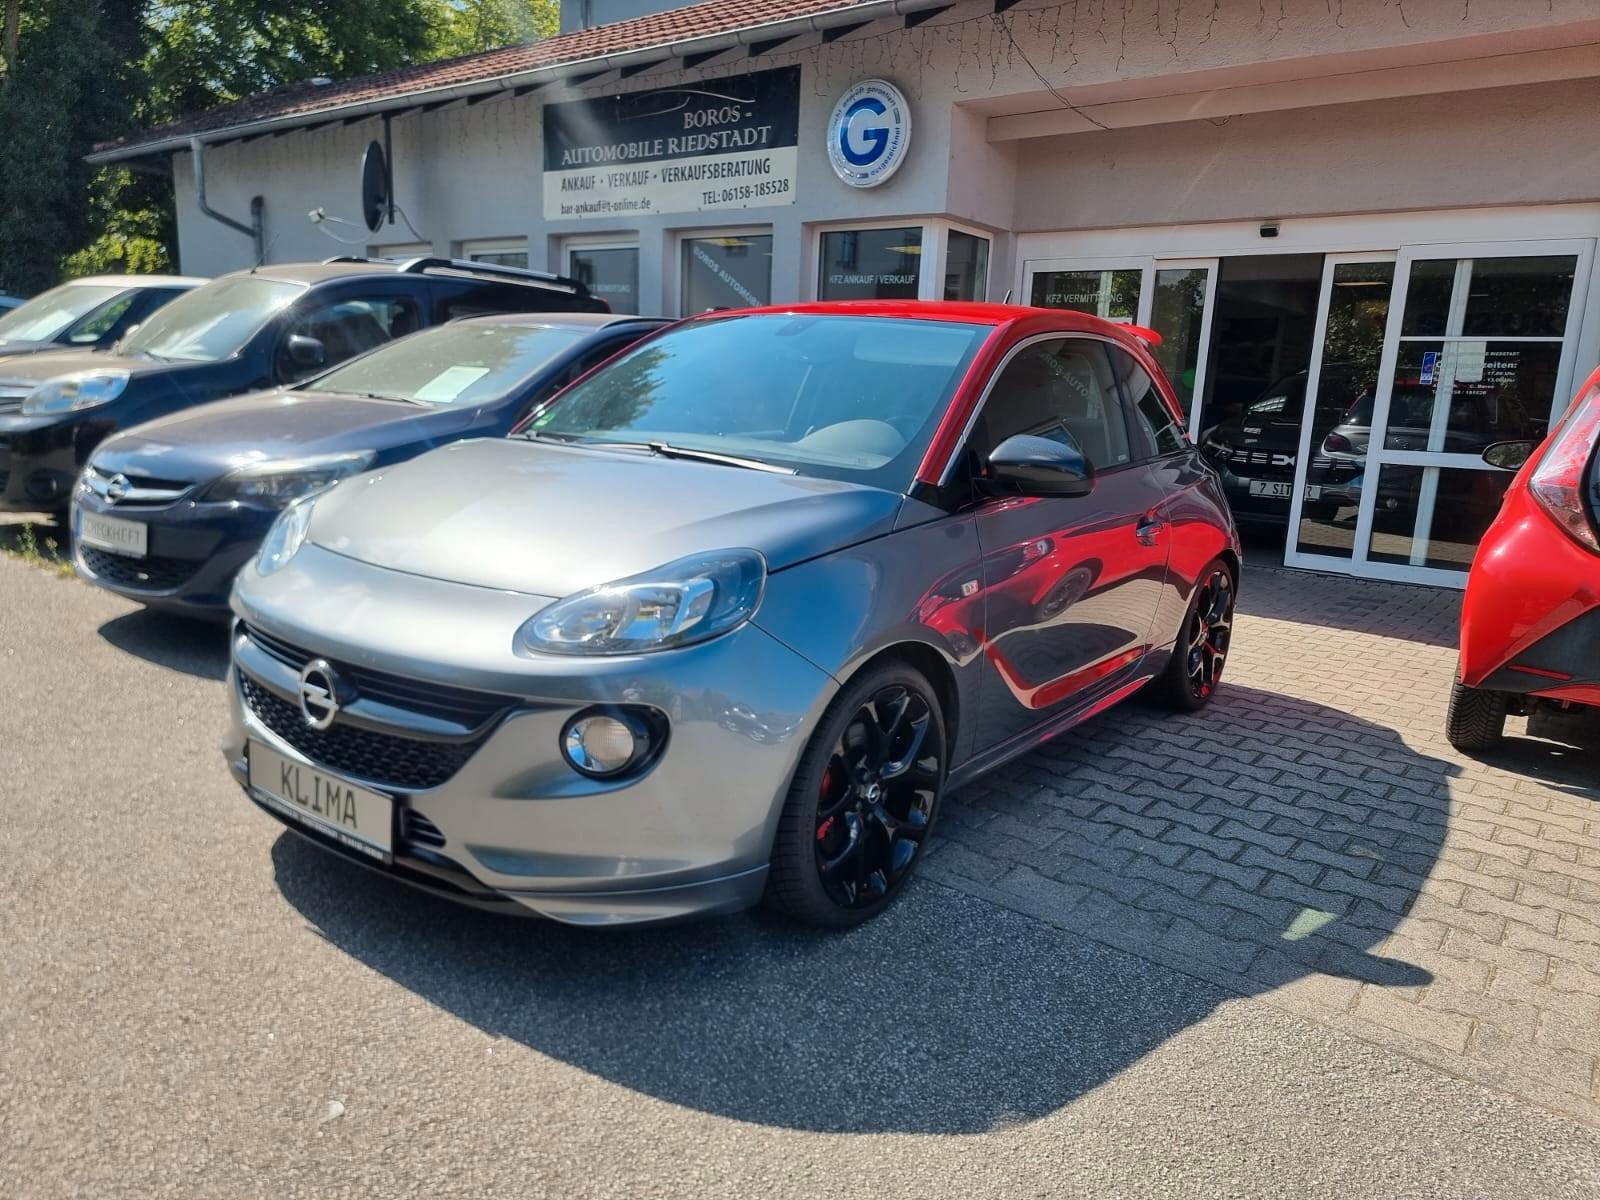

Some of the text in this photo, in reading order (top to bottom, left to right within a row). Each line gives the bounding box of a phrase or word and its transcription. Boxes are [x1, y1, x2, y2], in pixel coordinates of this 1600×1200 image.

[683, 104, 741, 129] BOROS
[840, 96, 890, 167] G
[561, 125, 772, 166] AUTOMOBILE RIEDSTADT
[561, 157, 771, 192] ANKAUF VERKAUF VERKAUFSBERATUNG
[843, 274, 875, 285] ANKAUF
[879, 274, 916, 285] VERKAUF
[1046, 293, 1123, 304] KFZ VERMITTNG
[280, 760, 358, 829] KLIMA
